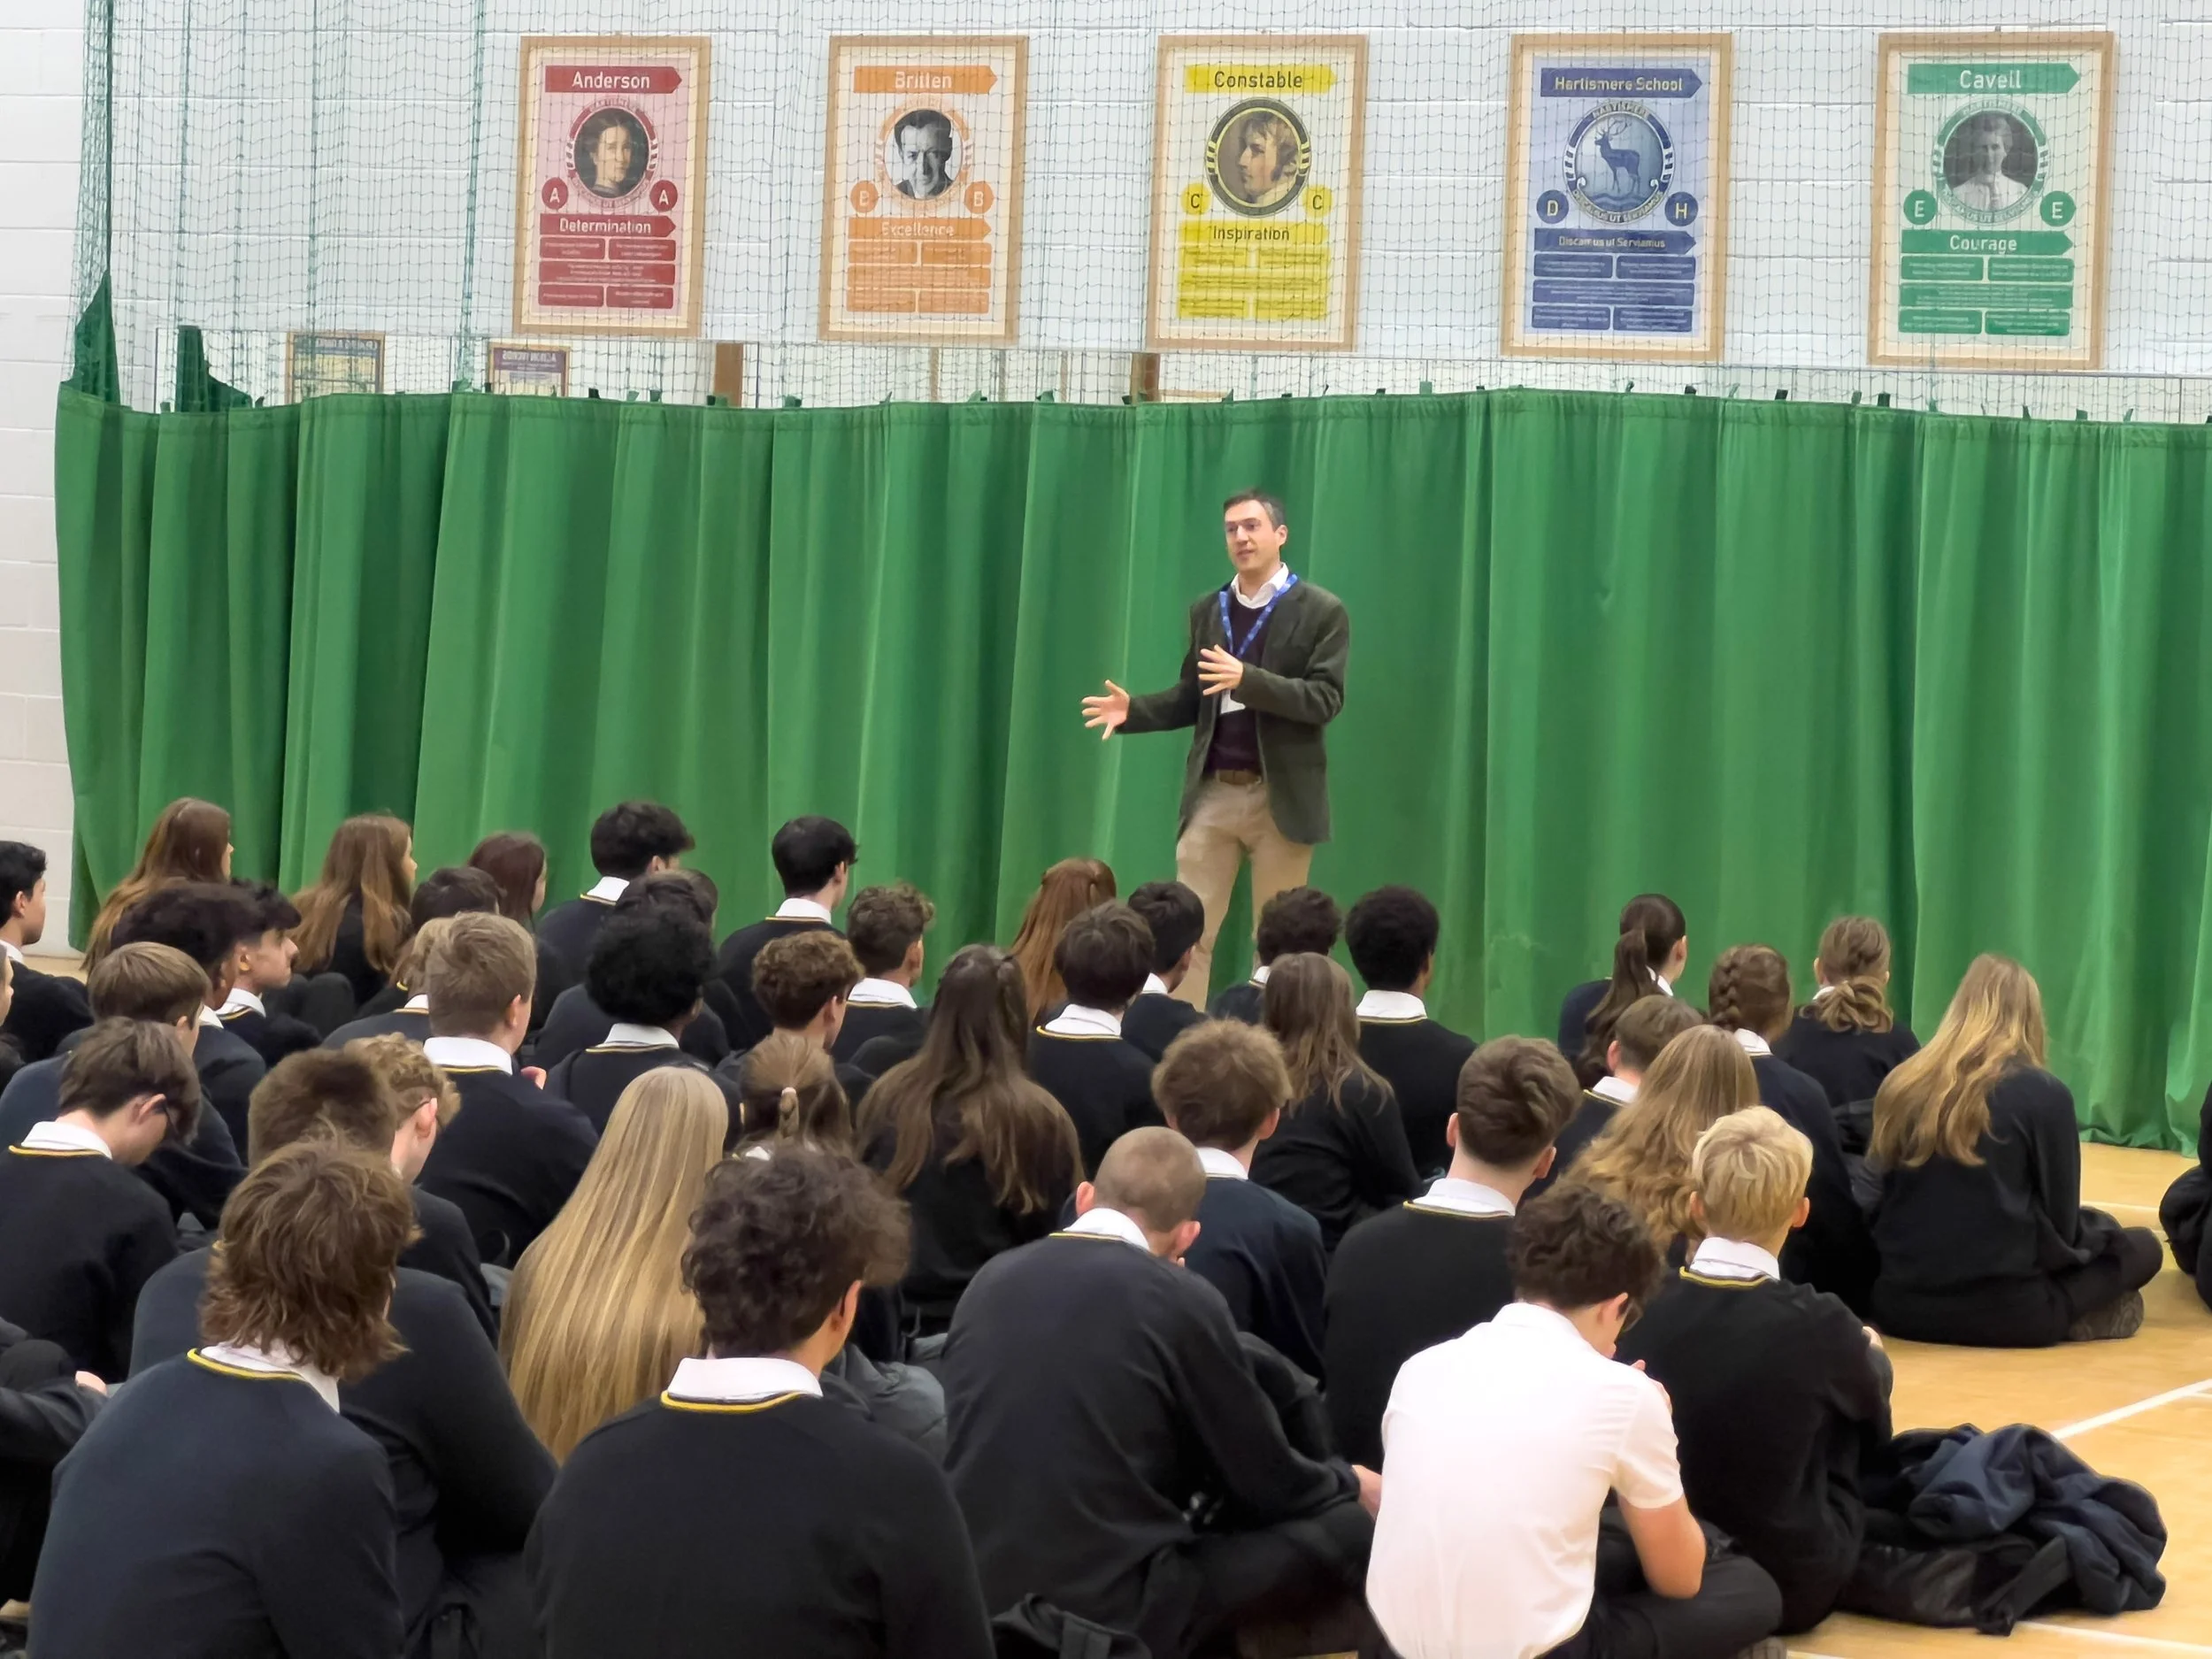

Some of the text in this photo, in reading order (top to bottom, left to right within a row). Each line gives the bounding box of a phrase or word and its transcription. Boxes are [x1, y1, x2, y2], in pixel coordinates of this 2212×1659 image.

[572, 71, 650, 89] Anderson
[895, 71, 952, 88] Britten
[1214, 71, 1302, 88] Constable
[1555, 77, 1683, 91] Hartismere School
[1959, 69, 2022, 89] Cavell
[549, 188, 560, 203] A
[658, 189, 670, 205] A
[973, 191, 984, 207] B
[1190, 193, 1200, 209] C
[1312, 195, 1323, 210] C
[1548, 200, 1558, 217] D
[1675, 202, 1687, 219] H
[1915, 200, 1925, 218] E
[2052, 201, 2063, 219] E
[559, 218, 651, 234] Determination
[881, 222, 955, 237] Excellence
[1213, 226, 1290, 243] Inspiration
[1949, 234, 2017, 254] Courage
